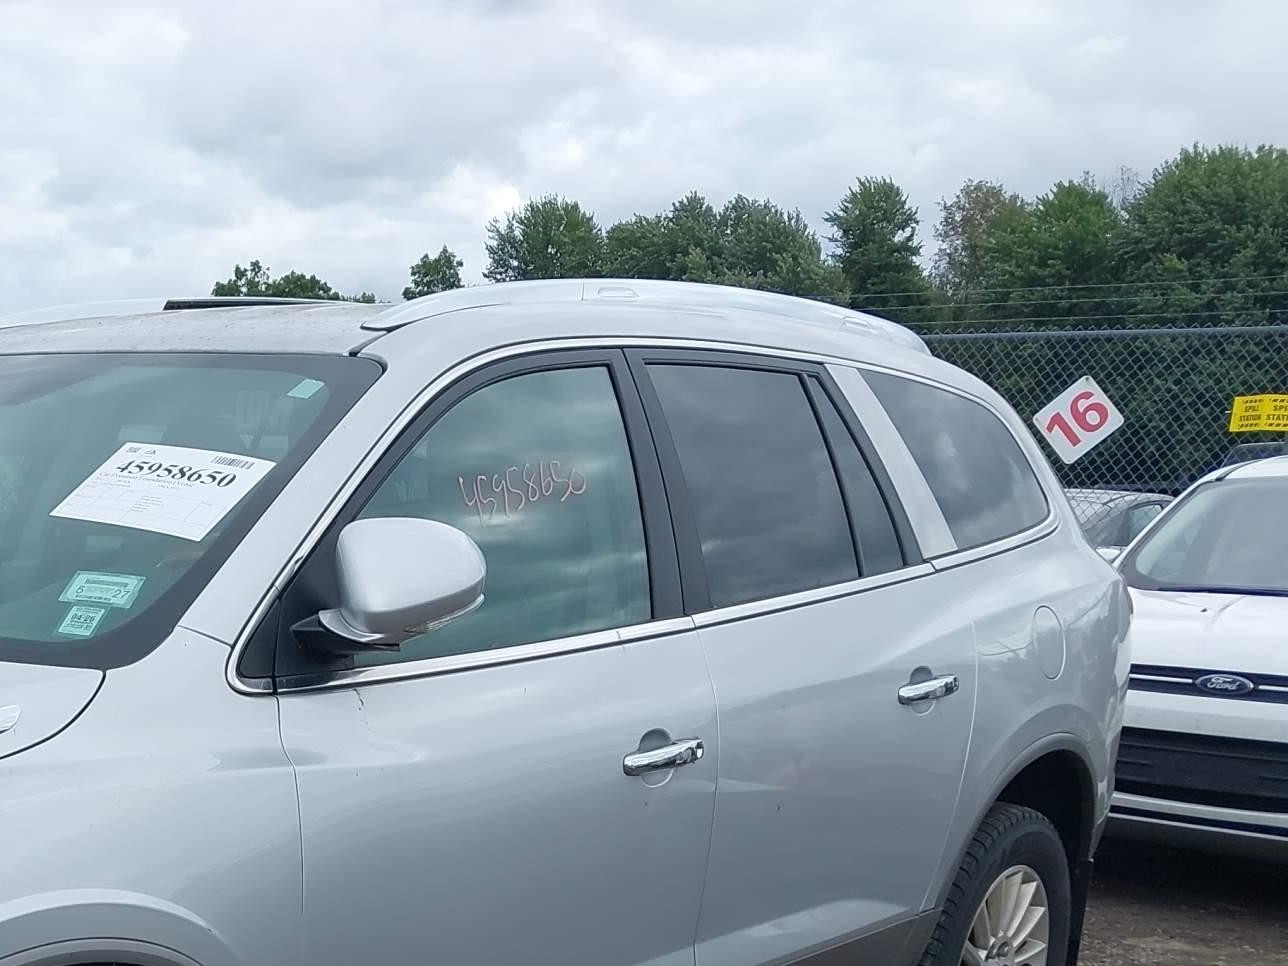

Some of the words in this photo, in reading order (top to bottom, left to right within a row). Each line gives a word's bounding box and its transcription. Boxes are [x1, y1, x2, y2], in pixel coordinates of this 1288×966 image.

[1046, 390, 1109, 448] 16
[116, 459, 237, 488] 45958650
[457, 460, 587, 527] 45958650
[111, 589, 131, 599] 27
[1206, 676, 1240, 691] Ford
